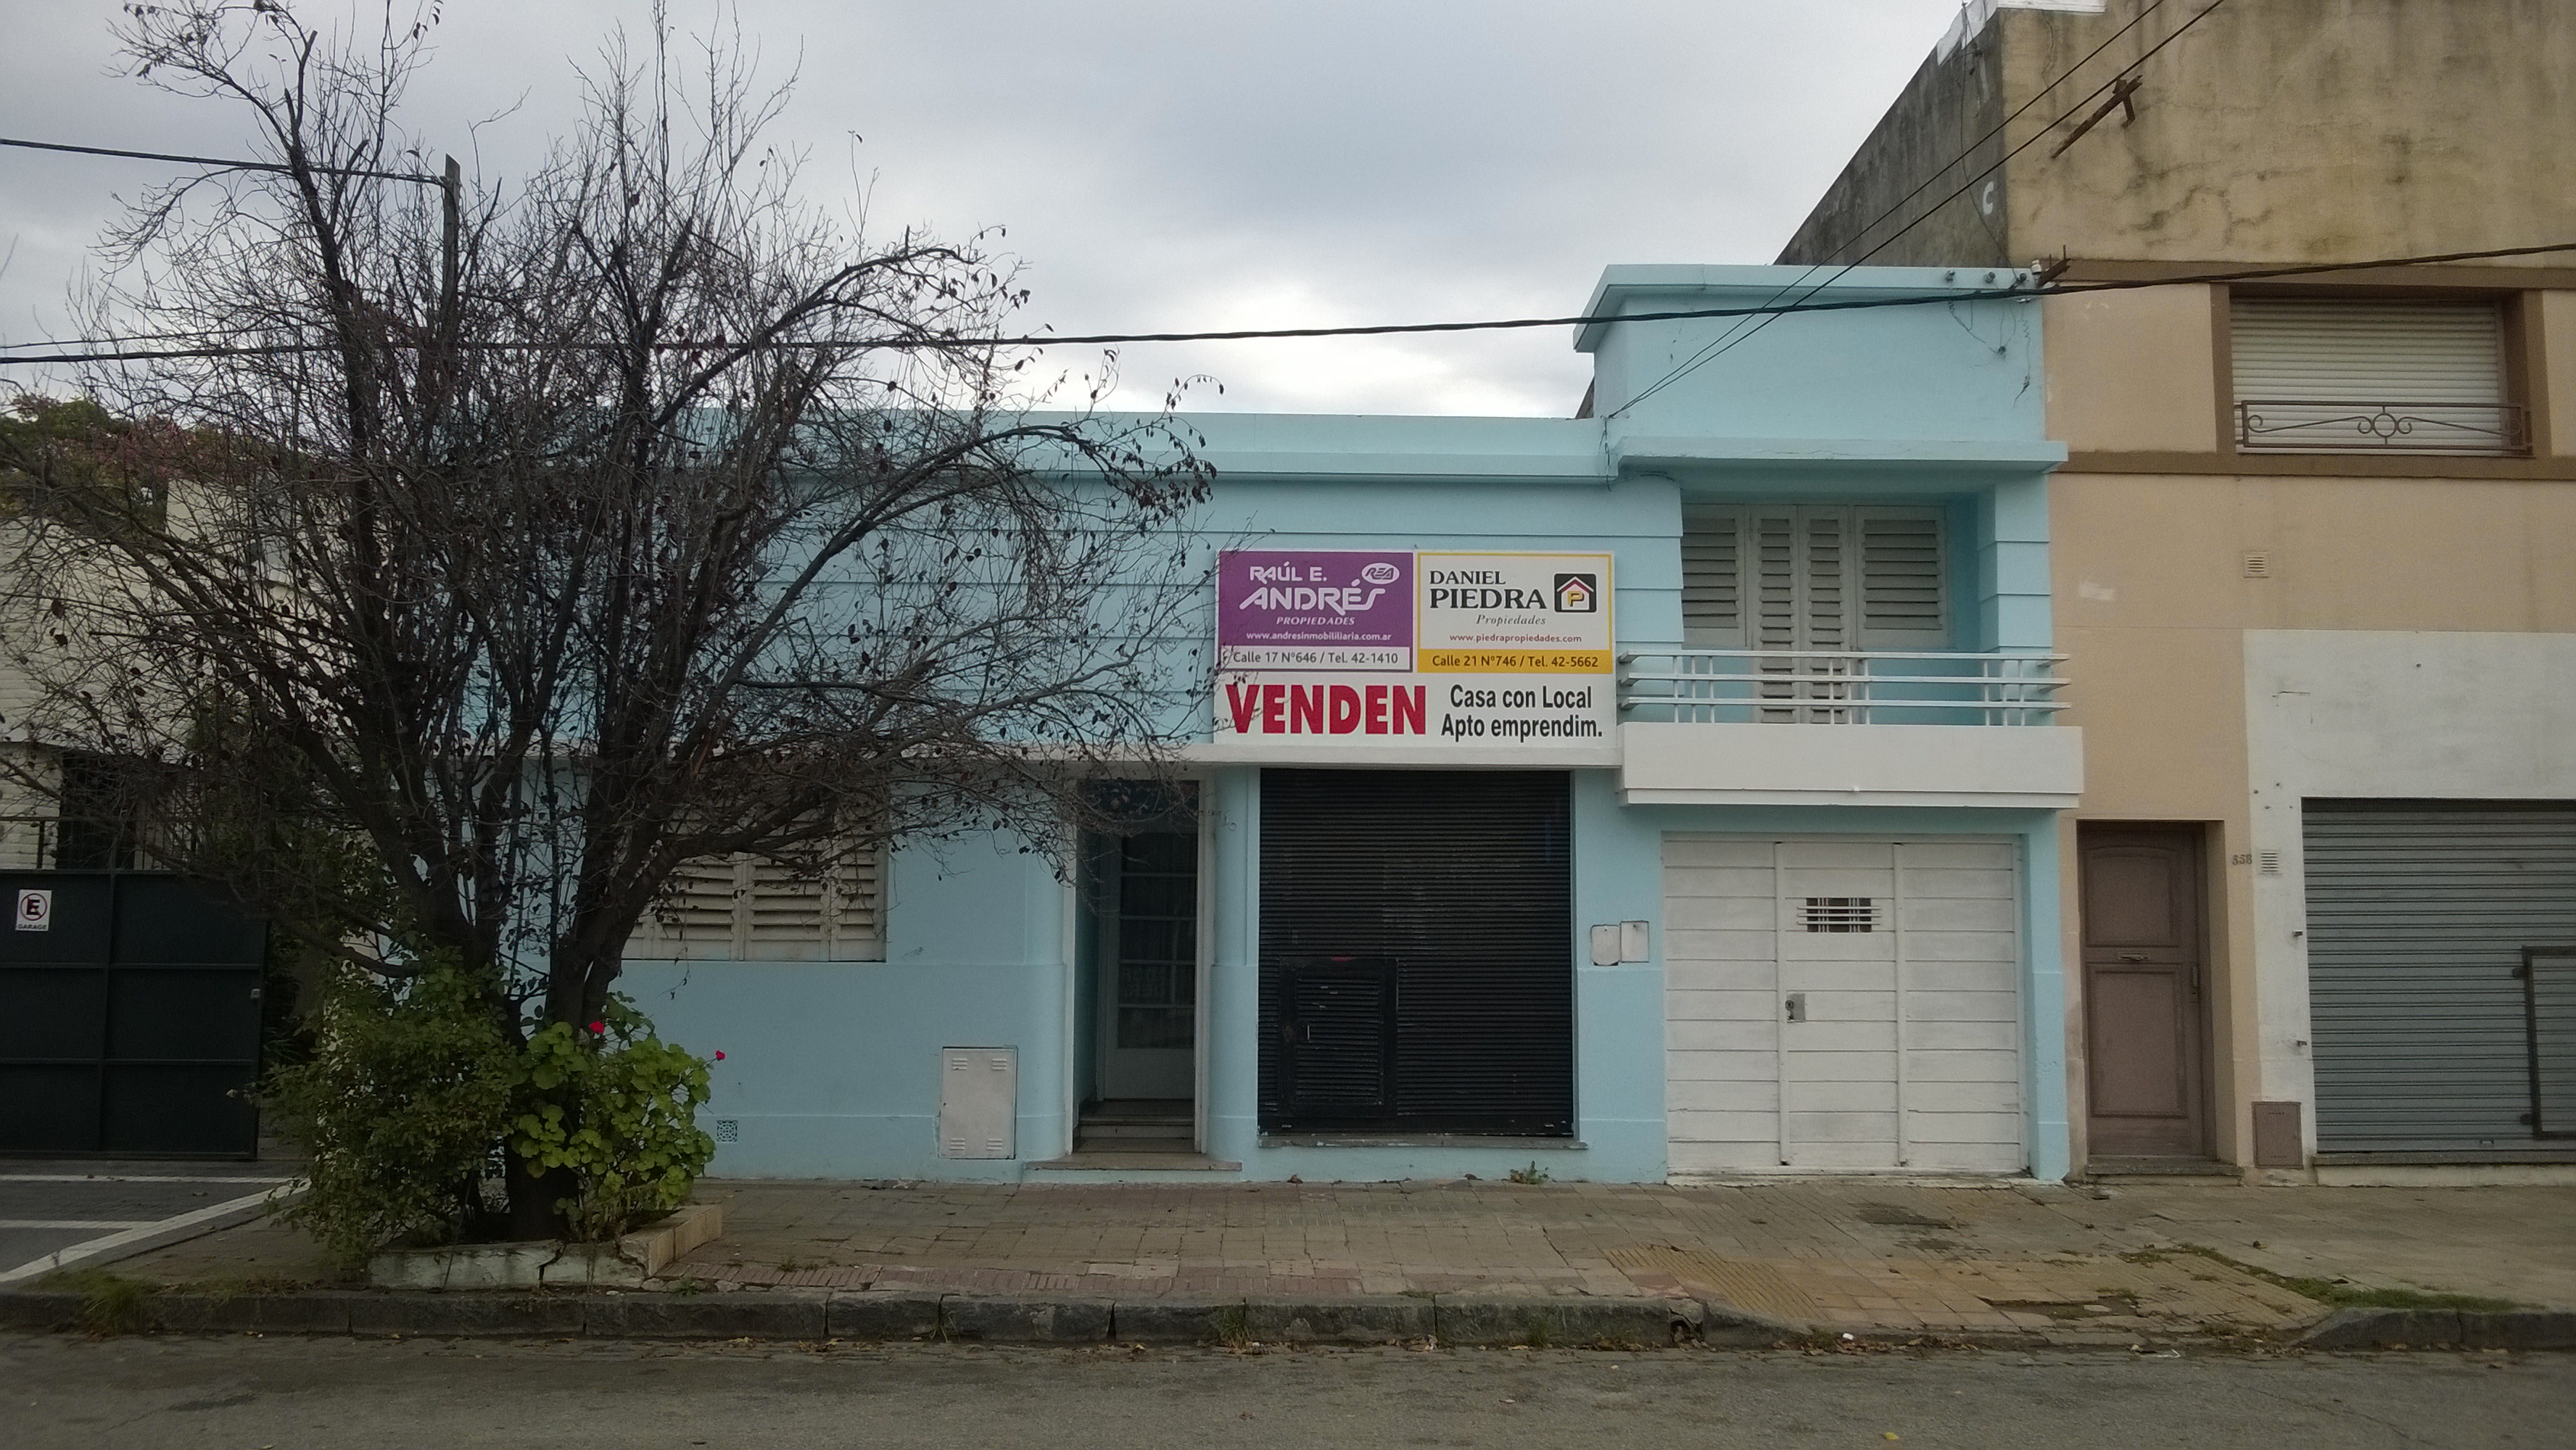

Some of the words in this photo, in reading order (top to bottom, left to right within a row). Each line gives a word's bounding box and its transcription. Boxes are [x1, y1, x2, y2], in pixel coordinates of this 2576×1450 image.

[1250, 561, 1303, 584] RAÚL
[1309, 566, 1327, 581] E.
[1364, 567, 1395, 581] REA
[1429, 571, 1506, 585] DANIEL
[1239, 579, 1386, 616] ANDRÉS
[1429, 588, 1548, 609] PIEDRA
[1276, 616, 1355, 626] PROPIEDADES
[1476, 614, 1546, 626] Propiedades
[1449, 633, 1582, 643] www.piedrapropiedades.com
[1233, 652, 1261, 663] Calle
[1265, 652, 1279, 663] 17
[1319, 652, 1325, 663] /
[1327, 652, 1348, 663] Tel.
[1350, 652, 1398, 664] 42-1410
[1432, 655, 1461, 666] Calle
[1464, 655, 1477, 666] 21
[1519, 655, 1524, 667] /
[1527, 655, 1548, 667] Tel.
[1551, 656, 1598, 668] 42-5662
[1450, 684, 1496, 708] Casa
[1502, 690, 1536, 708] con
[1543, 685, 1592, 708] Local
[1225, 684, 1426, 735] VENDEN
[1440, 713, 1485, 742] Apto
[1490, 714, 1603, 743] emprendim.
